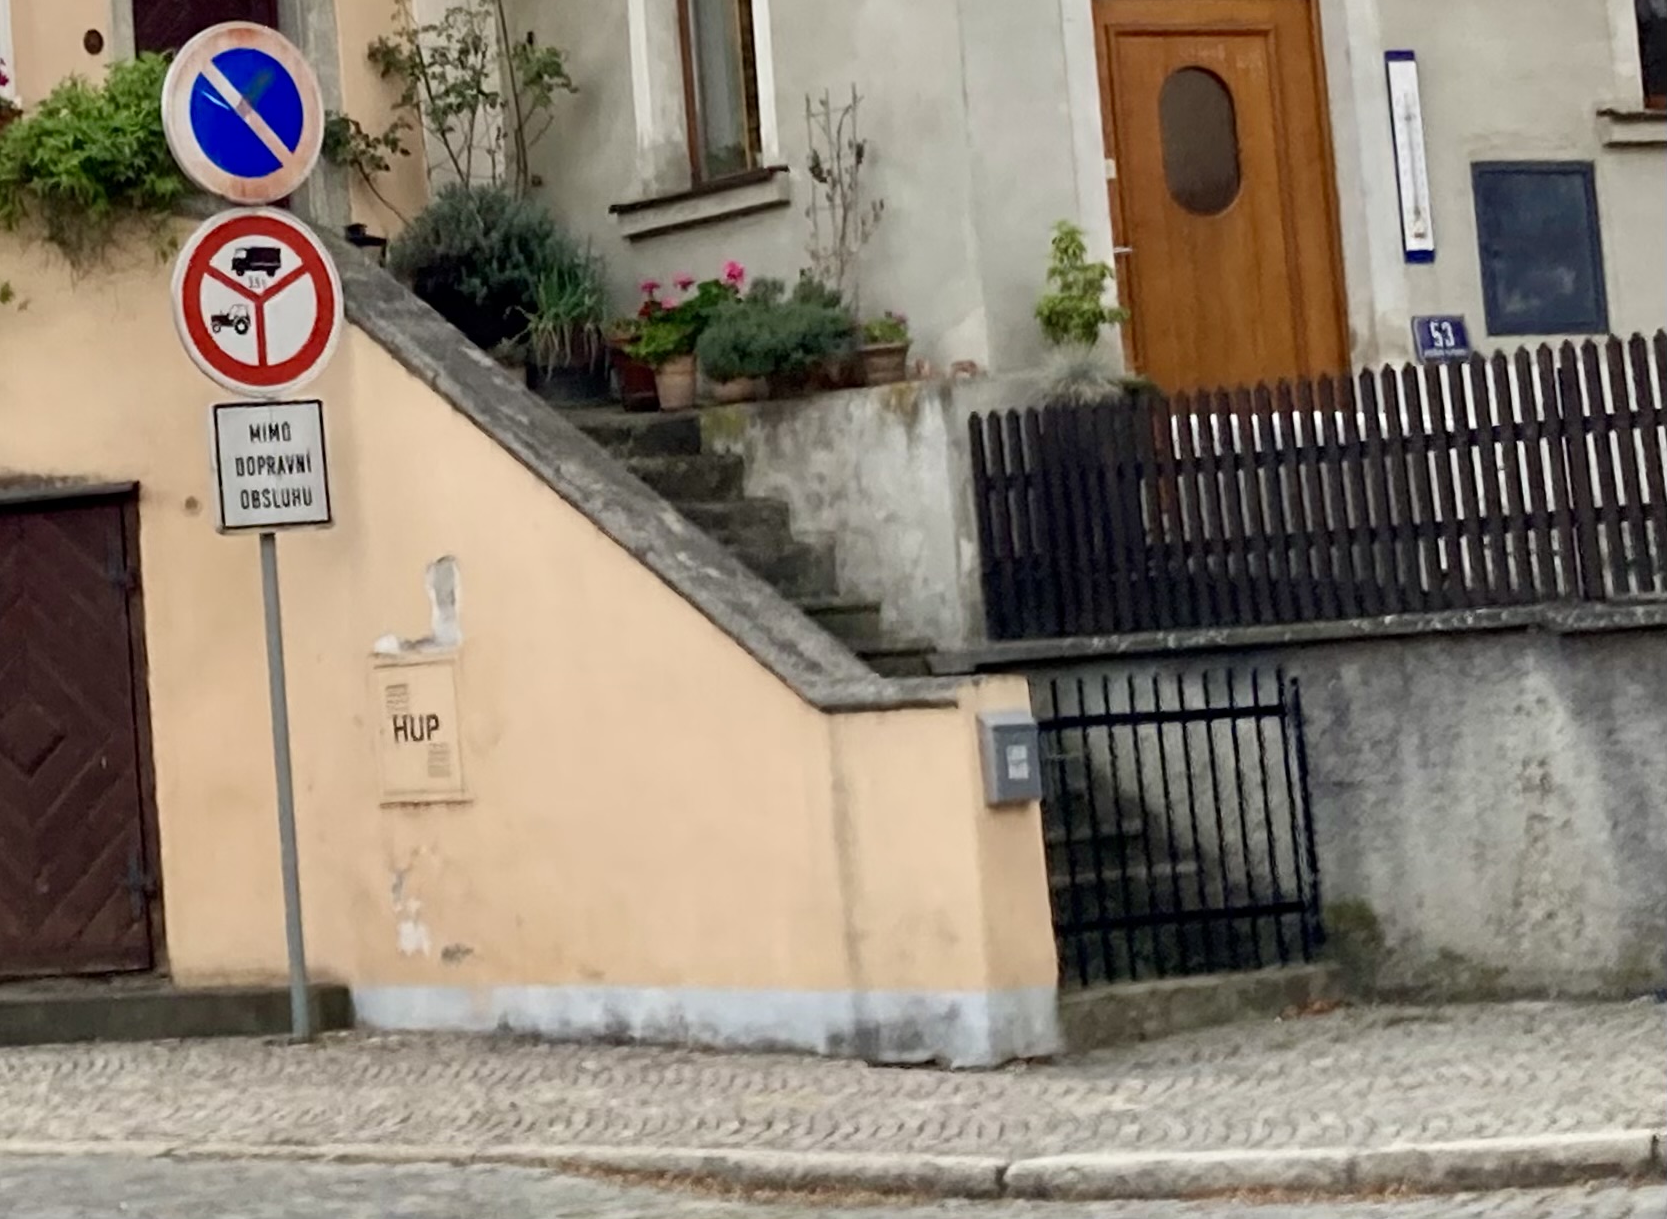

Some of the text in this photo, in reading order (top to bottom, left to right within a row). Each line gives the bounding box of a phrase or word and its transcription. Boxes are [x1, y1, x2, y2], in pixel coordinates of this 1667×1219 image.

[1429, 321, 1455, 348] 53
[248, 421, 292, 443] MIMO
[235, 449, 312, 477] DOPRAVNÍ
[240, 486, 313, 510] OBSLUHU
[392, 713, 440, 743] HUP
